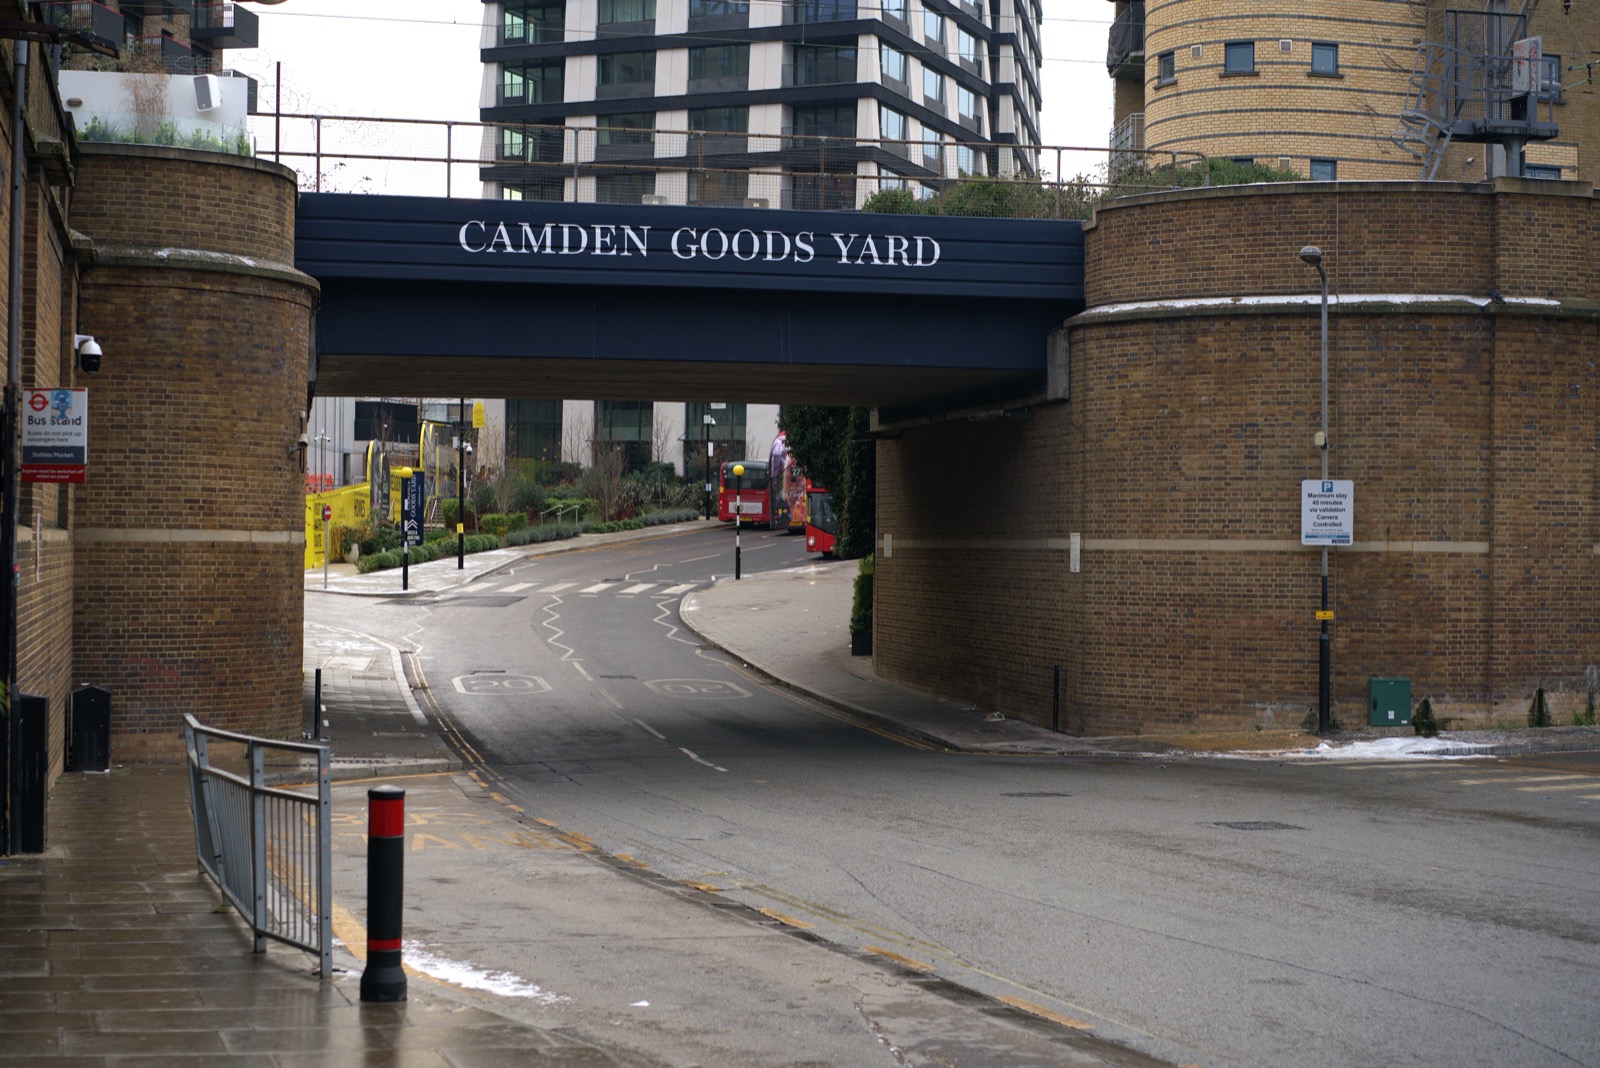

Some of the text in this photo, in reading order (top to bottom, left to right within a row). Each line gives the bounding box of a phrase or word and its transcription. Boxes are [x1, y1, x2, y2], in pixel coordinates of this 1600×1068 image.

[458, 219, 941, 268] CAMDEN GOODS YARD
[27, 415, 82, 426] Bus stand
[1323, 482, 1331, 492] P
[471, 678, 535, 690] 20
